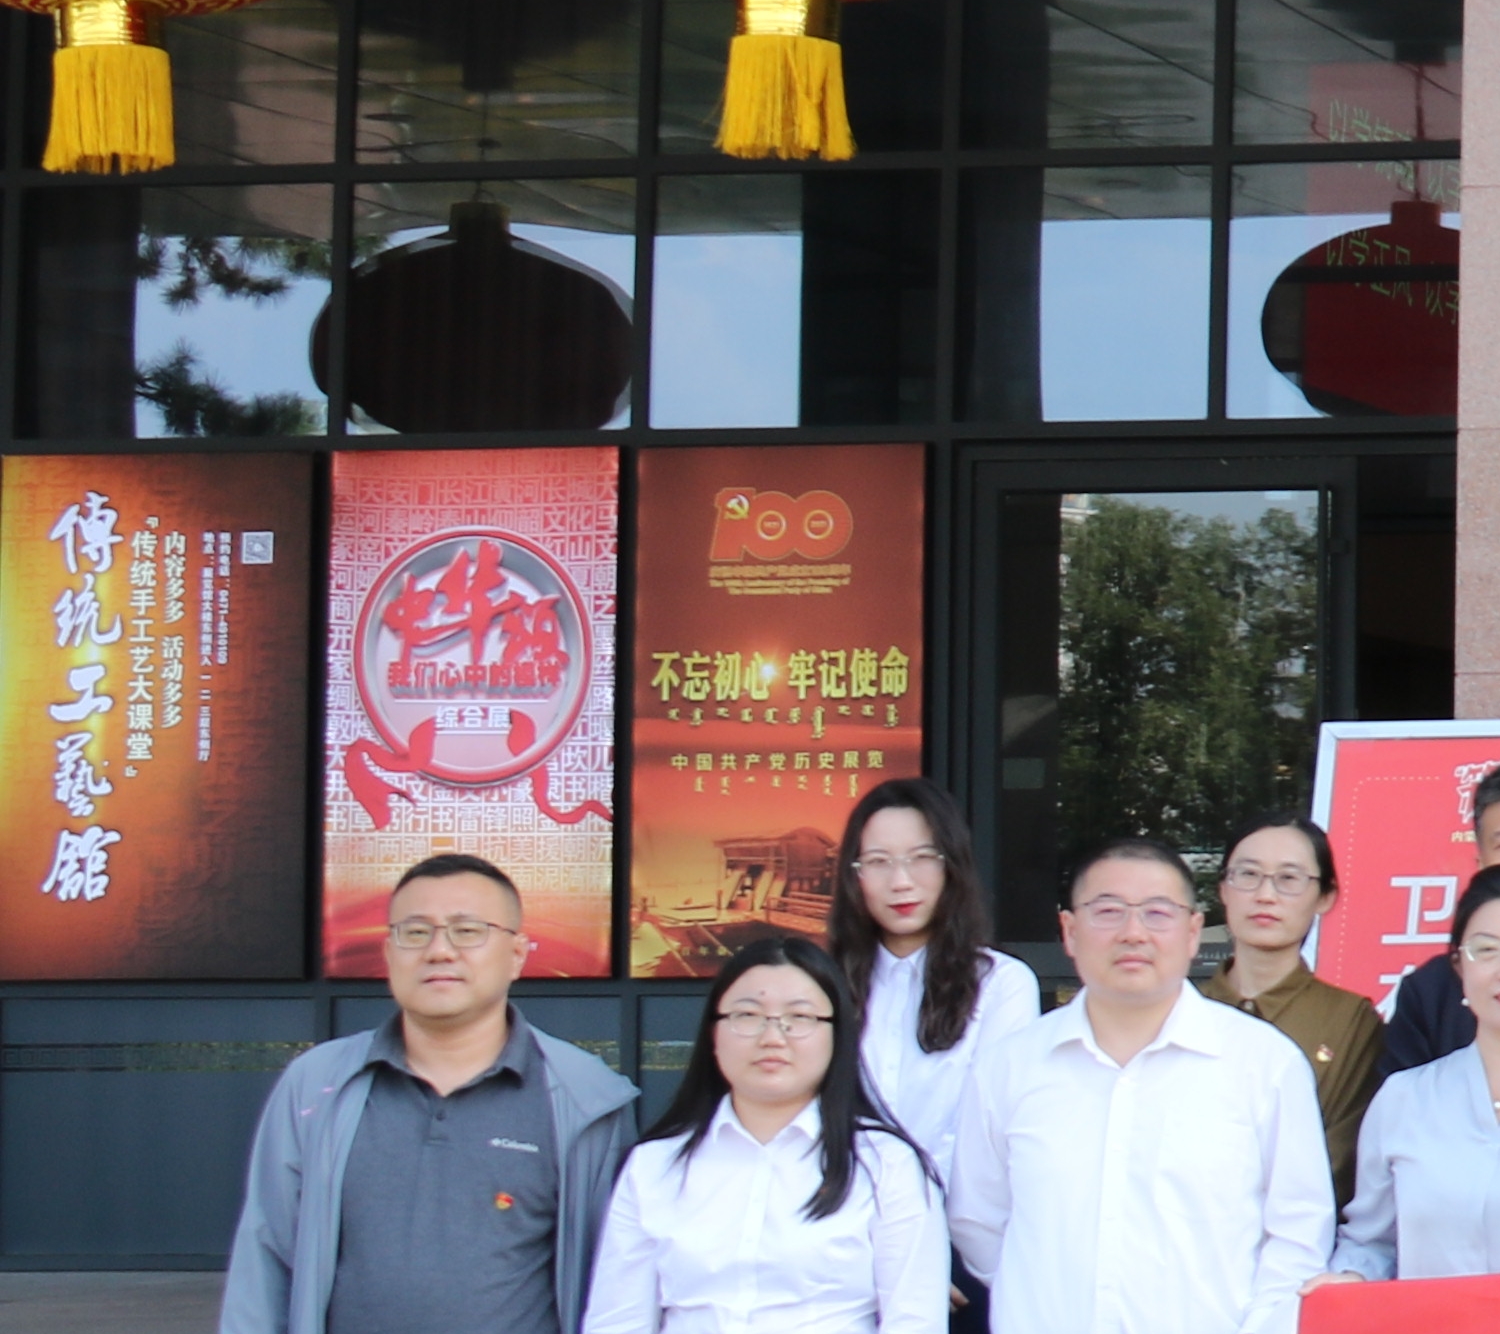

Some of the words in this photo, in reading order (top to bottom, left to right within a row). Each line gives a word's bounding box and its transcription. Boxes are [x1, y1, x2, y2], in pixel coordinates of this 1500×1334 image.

[162, 531, 187, 625] 内容多多
[160, 636, 185, 729] 活动多多
[651, 651, 770, 701] 不忘初心
[788, 646, 909, 700] 牢记使命
[436, 705, 511, 729] 综合展
[671, 750, 883, 771] 中国共产党历史展览
